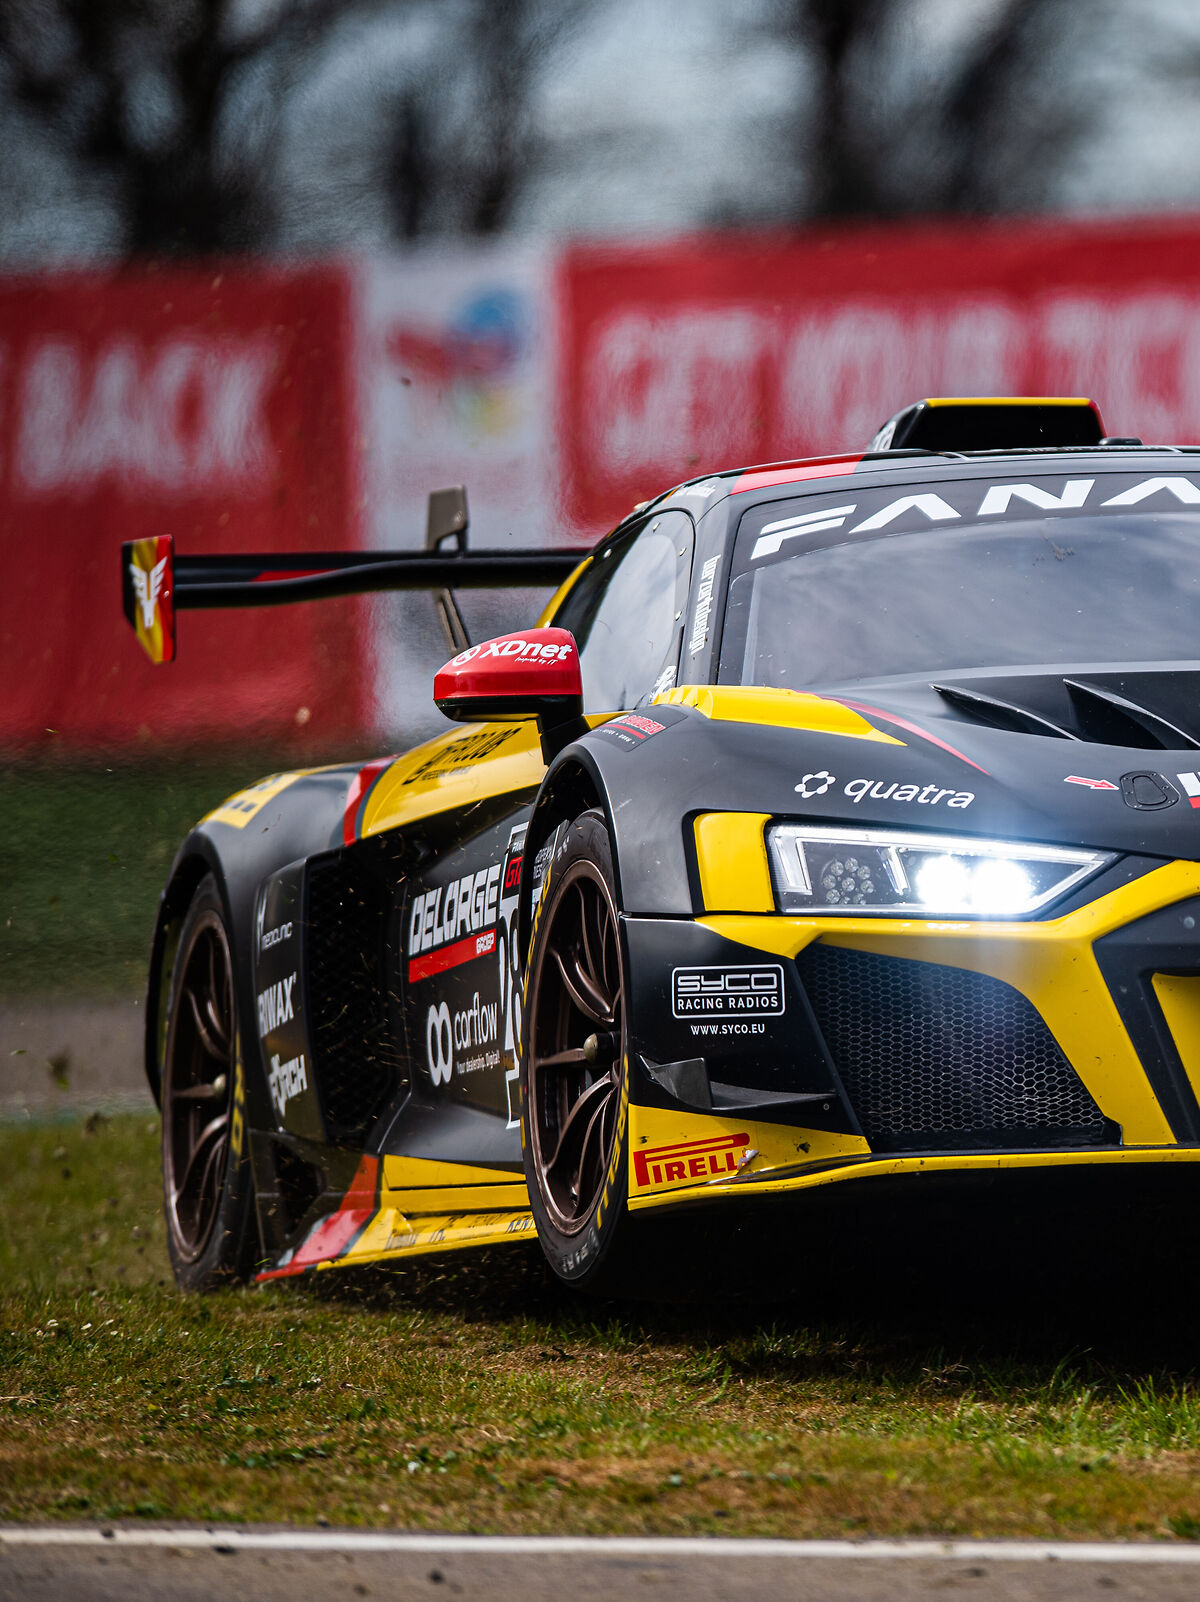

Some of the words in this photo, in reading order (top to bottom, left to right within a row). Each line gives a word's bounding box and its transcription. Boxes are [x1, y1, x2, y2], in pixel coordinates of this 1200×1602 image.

[479, 640, 573, 660] XDnet
[843, 778, 975, 808] quatra
[408, 864, 501, 956] DELORGE
[678, 973, 777, 992] SYCO
[678, 998, 723, 1010] RACING
[729, 996, 778, 1009] RADIOS
[454, 991, 498, 1051] carflow
[690, 1023, 765, 1035] WWW.SYCO.EU
